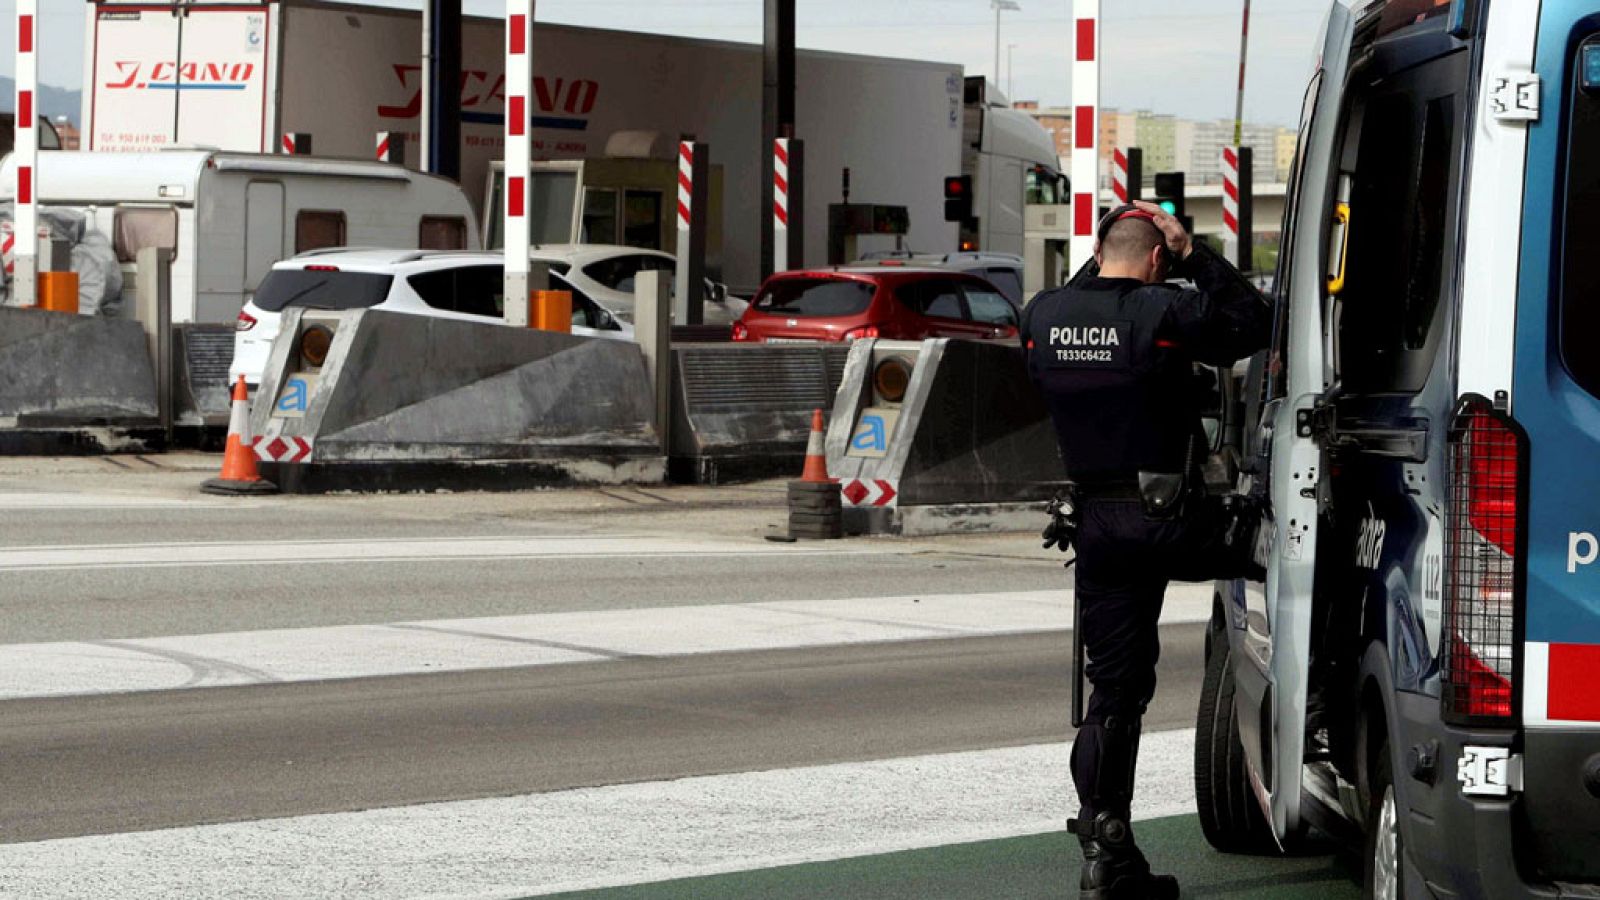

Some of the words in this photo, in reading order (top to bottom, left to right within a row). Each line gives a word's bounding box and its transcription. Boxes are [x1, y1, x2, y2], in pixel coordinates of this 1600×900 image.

[1049, 327, 1119, 346] POLICIA
[1056, 350, 1112, 362] T833C6422
[1425, 554, 1440, 591] 112
